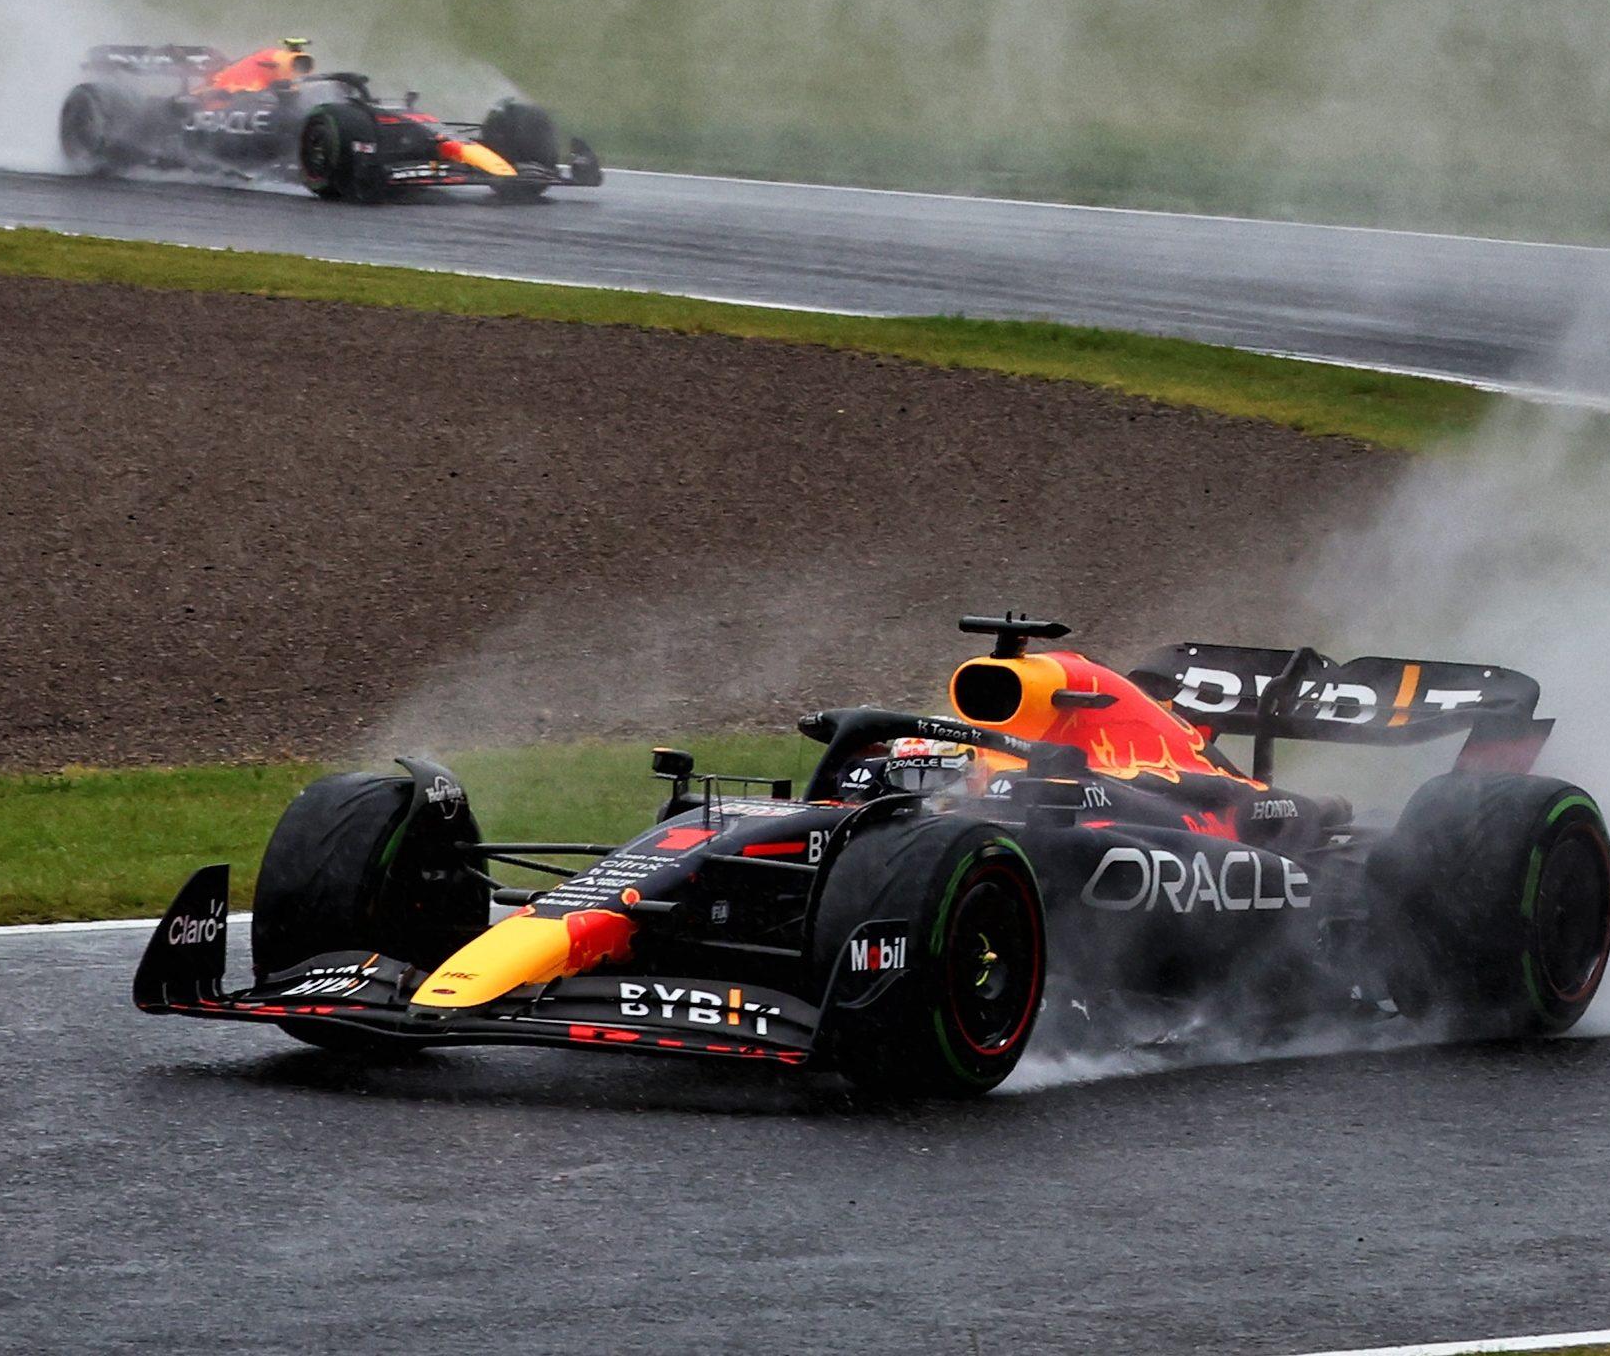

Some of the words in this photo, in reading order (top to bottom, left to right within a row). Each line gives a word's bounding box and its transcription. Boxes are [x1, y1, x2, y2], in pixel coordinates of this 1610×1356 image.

[1250, 799, 1299, 821] HONDA
[1080, 847, 1311, 914] ORACLE
[168, 915, 217, 945] Claro
[850, 936, 907, 972] Mobil
[619, 982, 781, 1036] BYBIT
